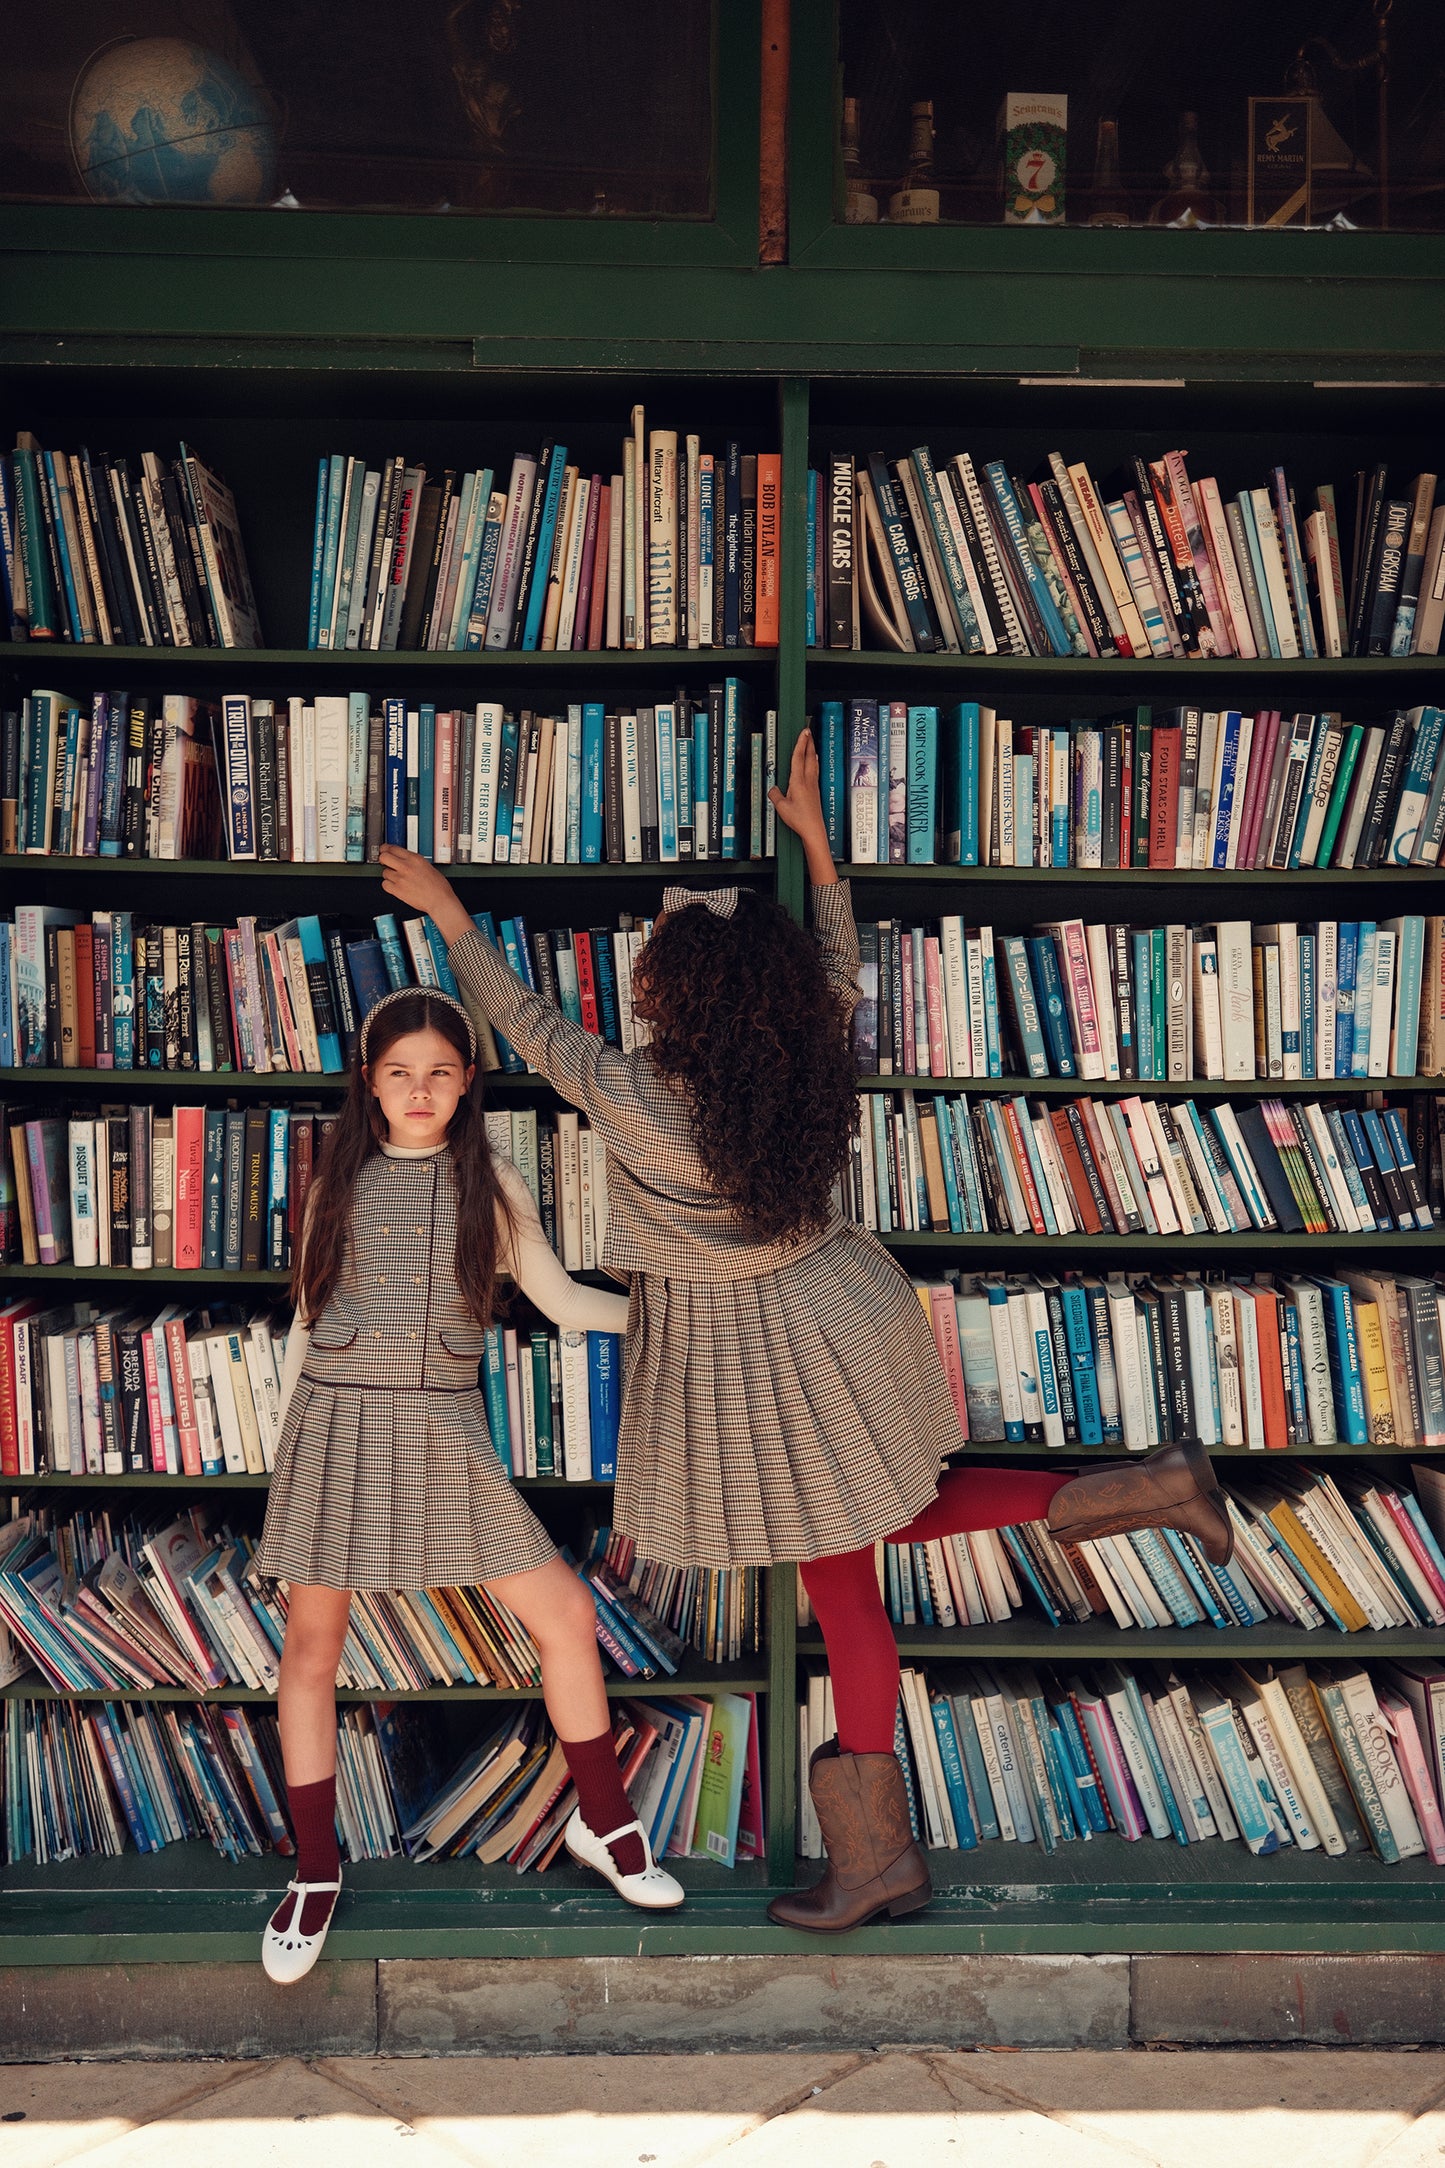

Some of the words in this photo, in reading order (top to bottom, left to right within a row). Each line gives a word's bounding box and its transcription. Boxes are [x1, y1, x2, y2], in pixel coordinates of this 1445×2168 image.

[1013, 105, 1062, 118] Seagram's
[1026, 160, 1045, 189] 7
[1278, 154, 1303, 163] MARTIN
[549, 453, 563, 489] LUXURY
[653, 448, 663, 484] Military
[13, 465, 27, 531] BENNINGTON
[516, 473, 526, 501] NORTH
[701, 475, 711, 510] LIONEL
[762, 484, 776, 509] BOB
[832, 462, 851, 523] MUSCLE
[546, 491, 556, 524] TRAINS
[654, 487, 664, 523] Aircraft
[729, 513, 737, 528] The
[1387, 504, 1407, 532] JOHN
[507, 504, 521, 550] AMERICAN
[743, 509, 755, 543] Indian
[762, 515, 776, 557] DYLAN
[1166, 506, 1189, 562] butterfly
[20, 535, 31, 562] Pottery
[482, 534, 492, 553] ON
[486, 528, 499, 570] WORLD
[728, 529, 737, 573] Lighthouse
[832, 529, 851, 569] CARS
[1145, 500, 1164, 547] AMERICAN
[1158, 550, 1182, 615] AUTOMOBILES
[24, 565, 32, 578] and
[478, 555, 490, 577] THE
[889, 523, 909, 555] CARS
[900, 566, 920, 601] 1960s
[1378, 549, 1401, 592] GRISHAM
[475, 580, 486, 599] AIR
[483, 572, 494, 595] WAR
[497, 552, 514, 612] LOCOMOTIVES
[742, 546, 755, 613] impressions
[26, 580, 36, 615] Porcelain
[480, 598, 490, 609] II
[111, 708, 119, 737] ANITA
[129, 709, 144, 749] SLANTED
[228, 705, 246, 742] TRUTH
[854, 709, 862, 753] PRINCESS
[861, 717, 870, 745] WHITE
[915, 713, 926, 748] ROBIN
[1186, 711, 1197, 734] GREG
[108, 740, 119, 774] SHREVE
[680, 741, 688, 754] THE
[1003, 745, 1011, 760] MY
[1159, 747, 1169, 775] FOUR
[1185, 737, 1196, 759] BEAR
[1326, 733, 1342, 759] The
[230, 750, 248, 786] DIVINE
[680, 756, 688, 786] MEXICAN
[915, 751, 926, 781] COOK
[479, 783, 489, 808] PETER
[680, 787, 688, 804] TREE
[1003, 763, 1012, 808] FATHER'S
[1158, 778, 1167, 808] STARS
[1314, 761, 1334, 808] Grudge
[104, 782, 115, 820] Testimony
[319, 791, 328, 838] LANDAU
[331, 796, 340, 832] DAVID
[680, 806, 689, 824] DUCK
[910, 784, 928, 834] MARKER
[478, 811, 489, 843] STRZOK
[1003, 811, 1013, 846] HOUSE
[1158, 811, 1166, 824] OF
[1156, 827, 1167, 850] HELL
[178, 934, 190, 956] Still
[949, 936, 957, 952] Am
[971, 948, 980, 963] WIL
[1170, 932, 1184, 978] Redemption
[1303, 940, 1311, 969] UNDER
[178, 958, 190, 985] River
[950, 955, 959, 986] Malala
[180, 991, 190, 1004] Hal
[971, 976, 983, 1005] HYLTON
[1304, 973, 1312, 1019] MAGNOLIA
[180, 1005, 190, 1037] Clement
[1171, 1004, 1184, 1028] NANCY
[973, 1019, 985, 1057] VANISHED
[1172, 1030, 1185, 1054] GEARY
[76, 1146, 87, 1186] DISQUIET
[189, 1139, 199, 1165] Yuval
[179, 1169, 189, 1200] Nexus
[189, 1169, 198, 1195] Noah
[251, 1153, 260, 1187] TRUNK
[1302, 1141, 1319, 1176] KATHARINE
[1314, 1177, 1330, 1207] HEPBURN
[78, 1194, 87, 1214] TIME
[189, 1199, 198, 1230] Harari
[250, 1190, 258, 1221] MUSIC
[1070, 1295, 1085, 1324] SHELDON
[1074, 1327, 1088, 1349] SIEGEL
[1170, 1299, 1180, 1343] JENNIFER
[1175, 1346, 1183, 1371] EGAN
[66, 1341, 74, 1364] TOM
[96, 1324, 112, 1382] WHIRLWIND
[599, 1339, 609, 1365] INSIDE
[1038, 1333, 1050, 1372] RONALD
[68, 1368, 76, 1400] WOLFE
[123, 1350, 132, 1391] NOVAK
[130, 1350, 140, 1391] BRENDA
[597, 1366, 610, 1380] JOB
[1080, 1374, 1092, 1393] FINAL
[1043, 1374, 1056, 1412] REAGAN
[1083, 1395, 1095, 1423] VERDICT
[1180, 1380, 1189, 1423] MANHATTAN
[1135, 1530, 1165, 1576] Diabetic
[1383, 1547, 1400, 1571] Chicken
[944, 1732, 952, 1750] ON
[951, 1763, 961, 1786] DIET
[997, 1725, 1015, 1771] catering
[1370, 1726, 1398, 1790] COOK'S
[1257, 1727, 1290, 1789] LOW-CARB
[1285, 1789, 1302, 1820] BIBLE
[1334, 1704, 1348, 1725] THE
[1342, 1726, 1363, 1773] Sunset
[1359, 1773, 1375, 1802] COOK
[1369, 1804, 1388, 1833] BOOK
